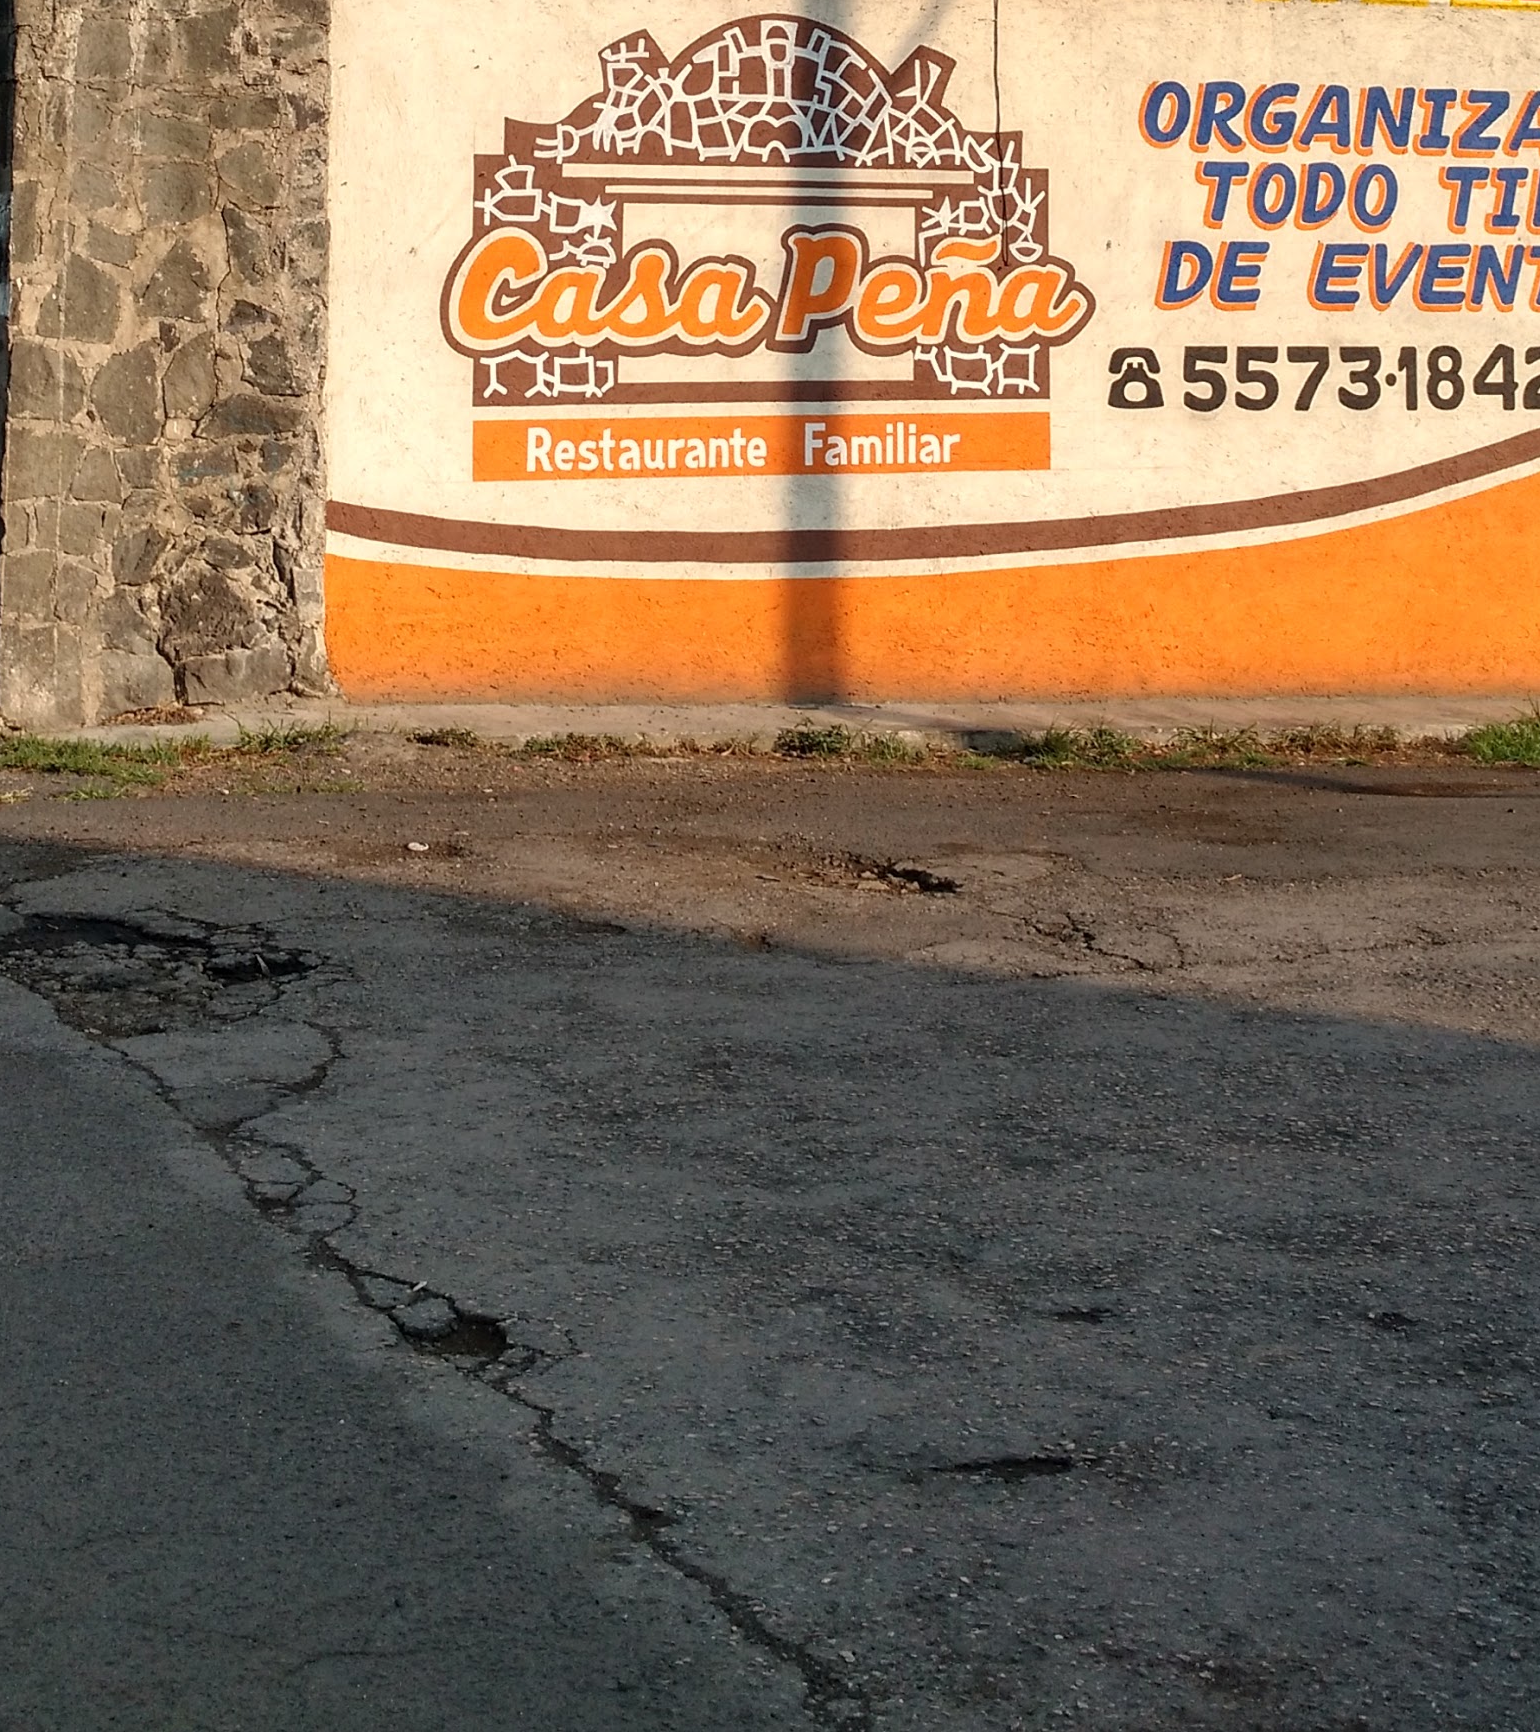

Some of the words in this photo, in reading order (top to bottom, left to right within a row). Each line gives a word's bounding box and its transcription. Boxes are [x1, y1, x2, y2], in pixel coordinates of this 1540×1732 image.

[1195, 161, 1399, 231] TODO
[447, 227, 771, 350] Casa
[776, 225, 1086, 349] Peña
[1155, 240, 1269, 311] DE
[527, 426, 767, 473] Restaurante
[803, 421, 961, 467] Familiar
